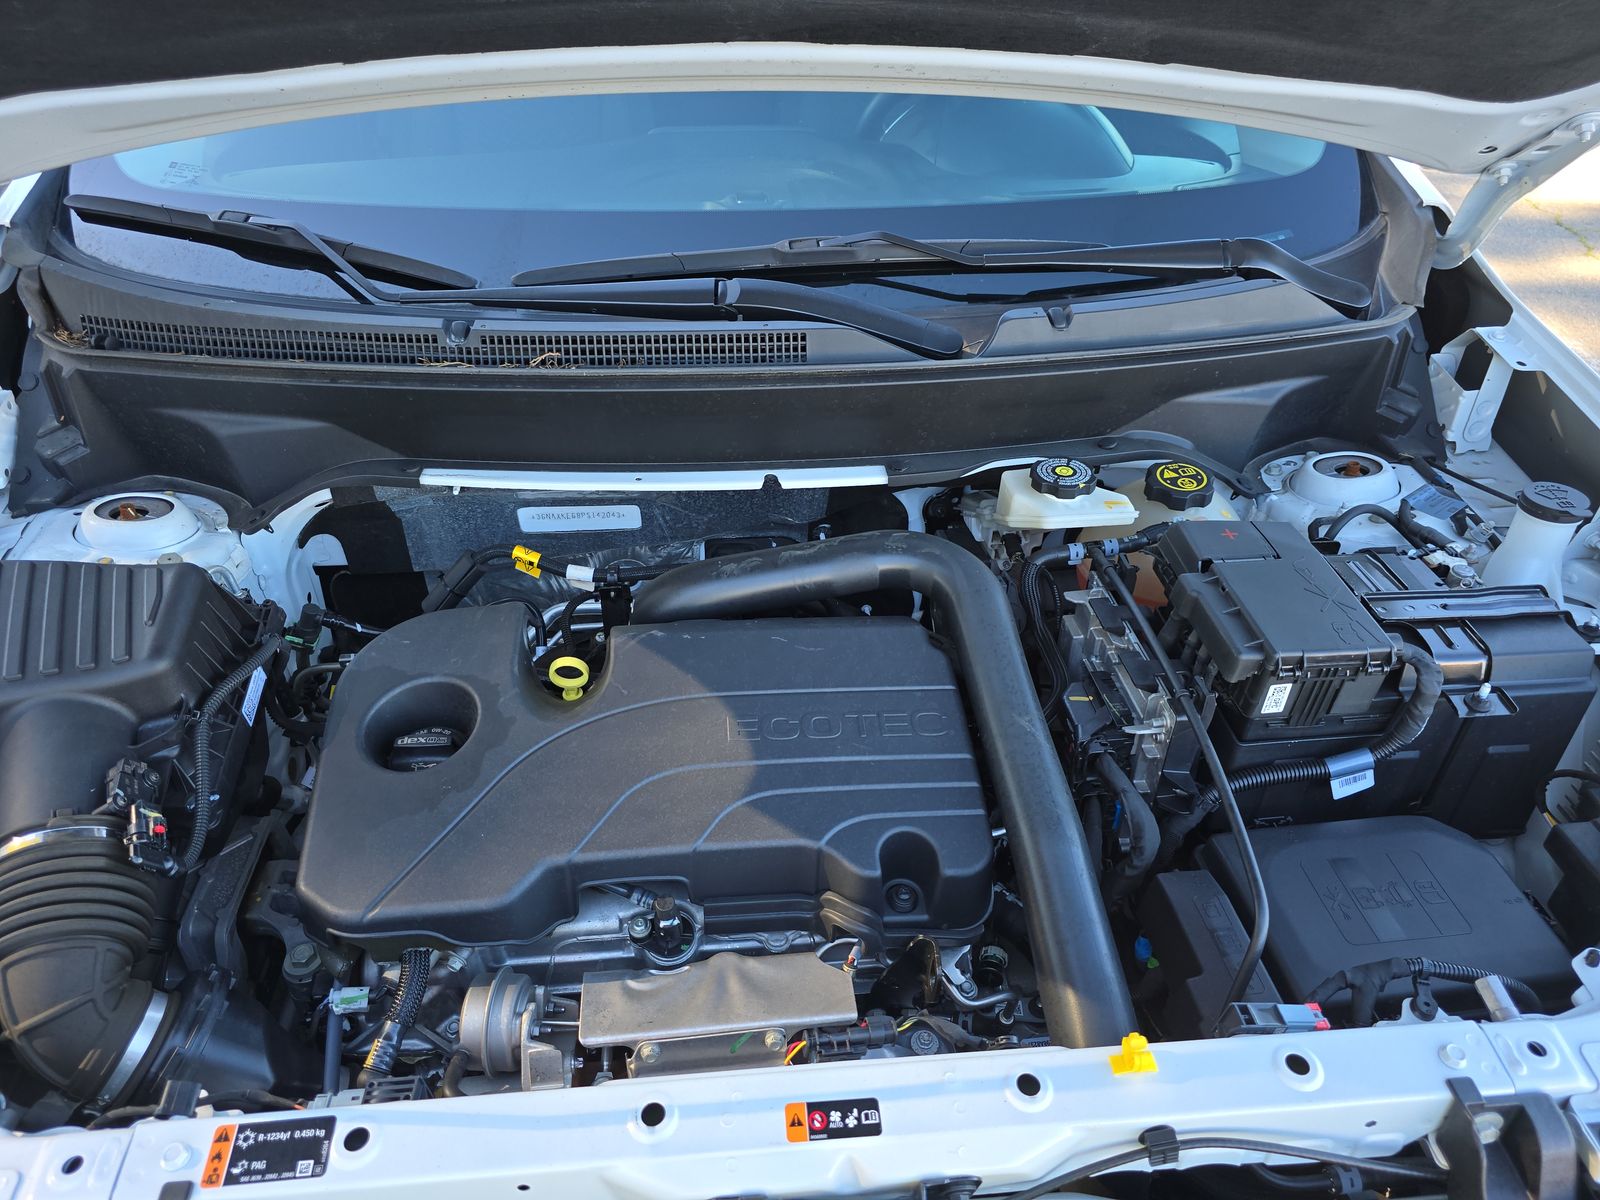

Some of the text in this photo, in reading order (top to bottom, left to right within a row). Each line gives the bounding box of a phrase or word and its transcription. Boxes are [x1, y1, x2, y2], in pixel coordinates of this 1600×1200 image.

[726, 711, 950, 742] ECOTEC
[257, 1128, 326, 1142] R-1234yf 0.450 kg
[250, 1160, 267, 1170] PAG
